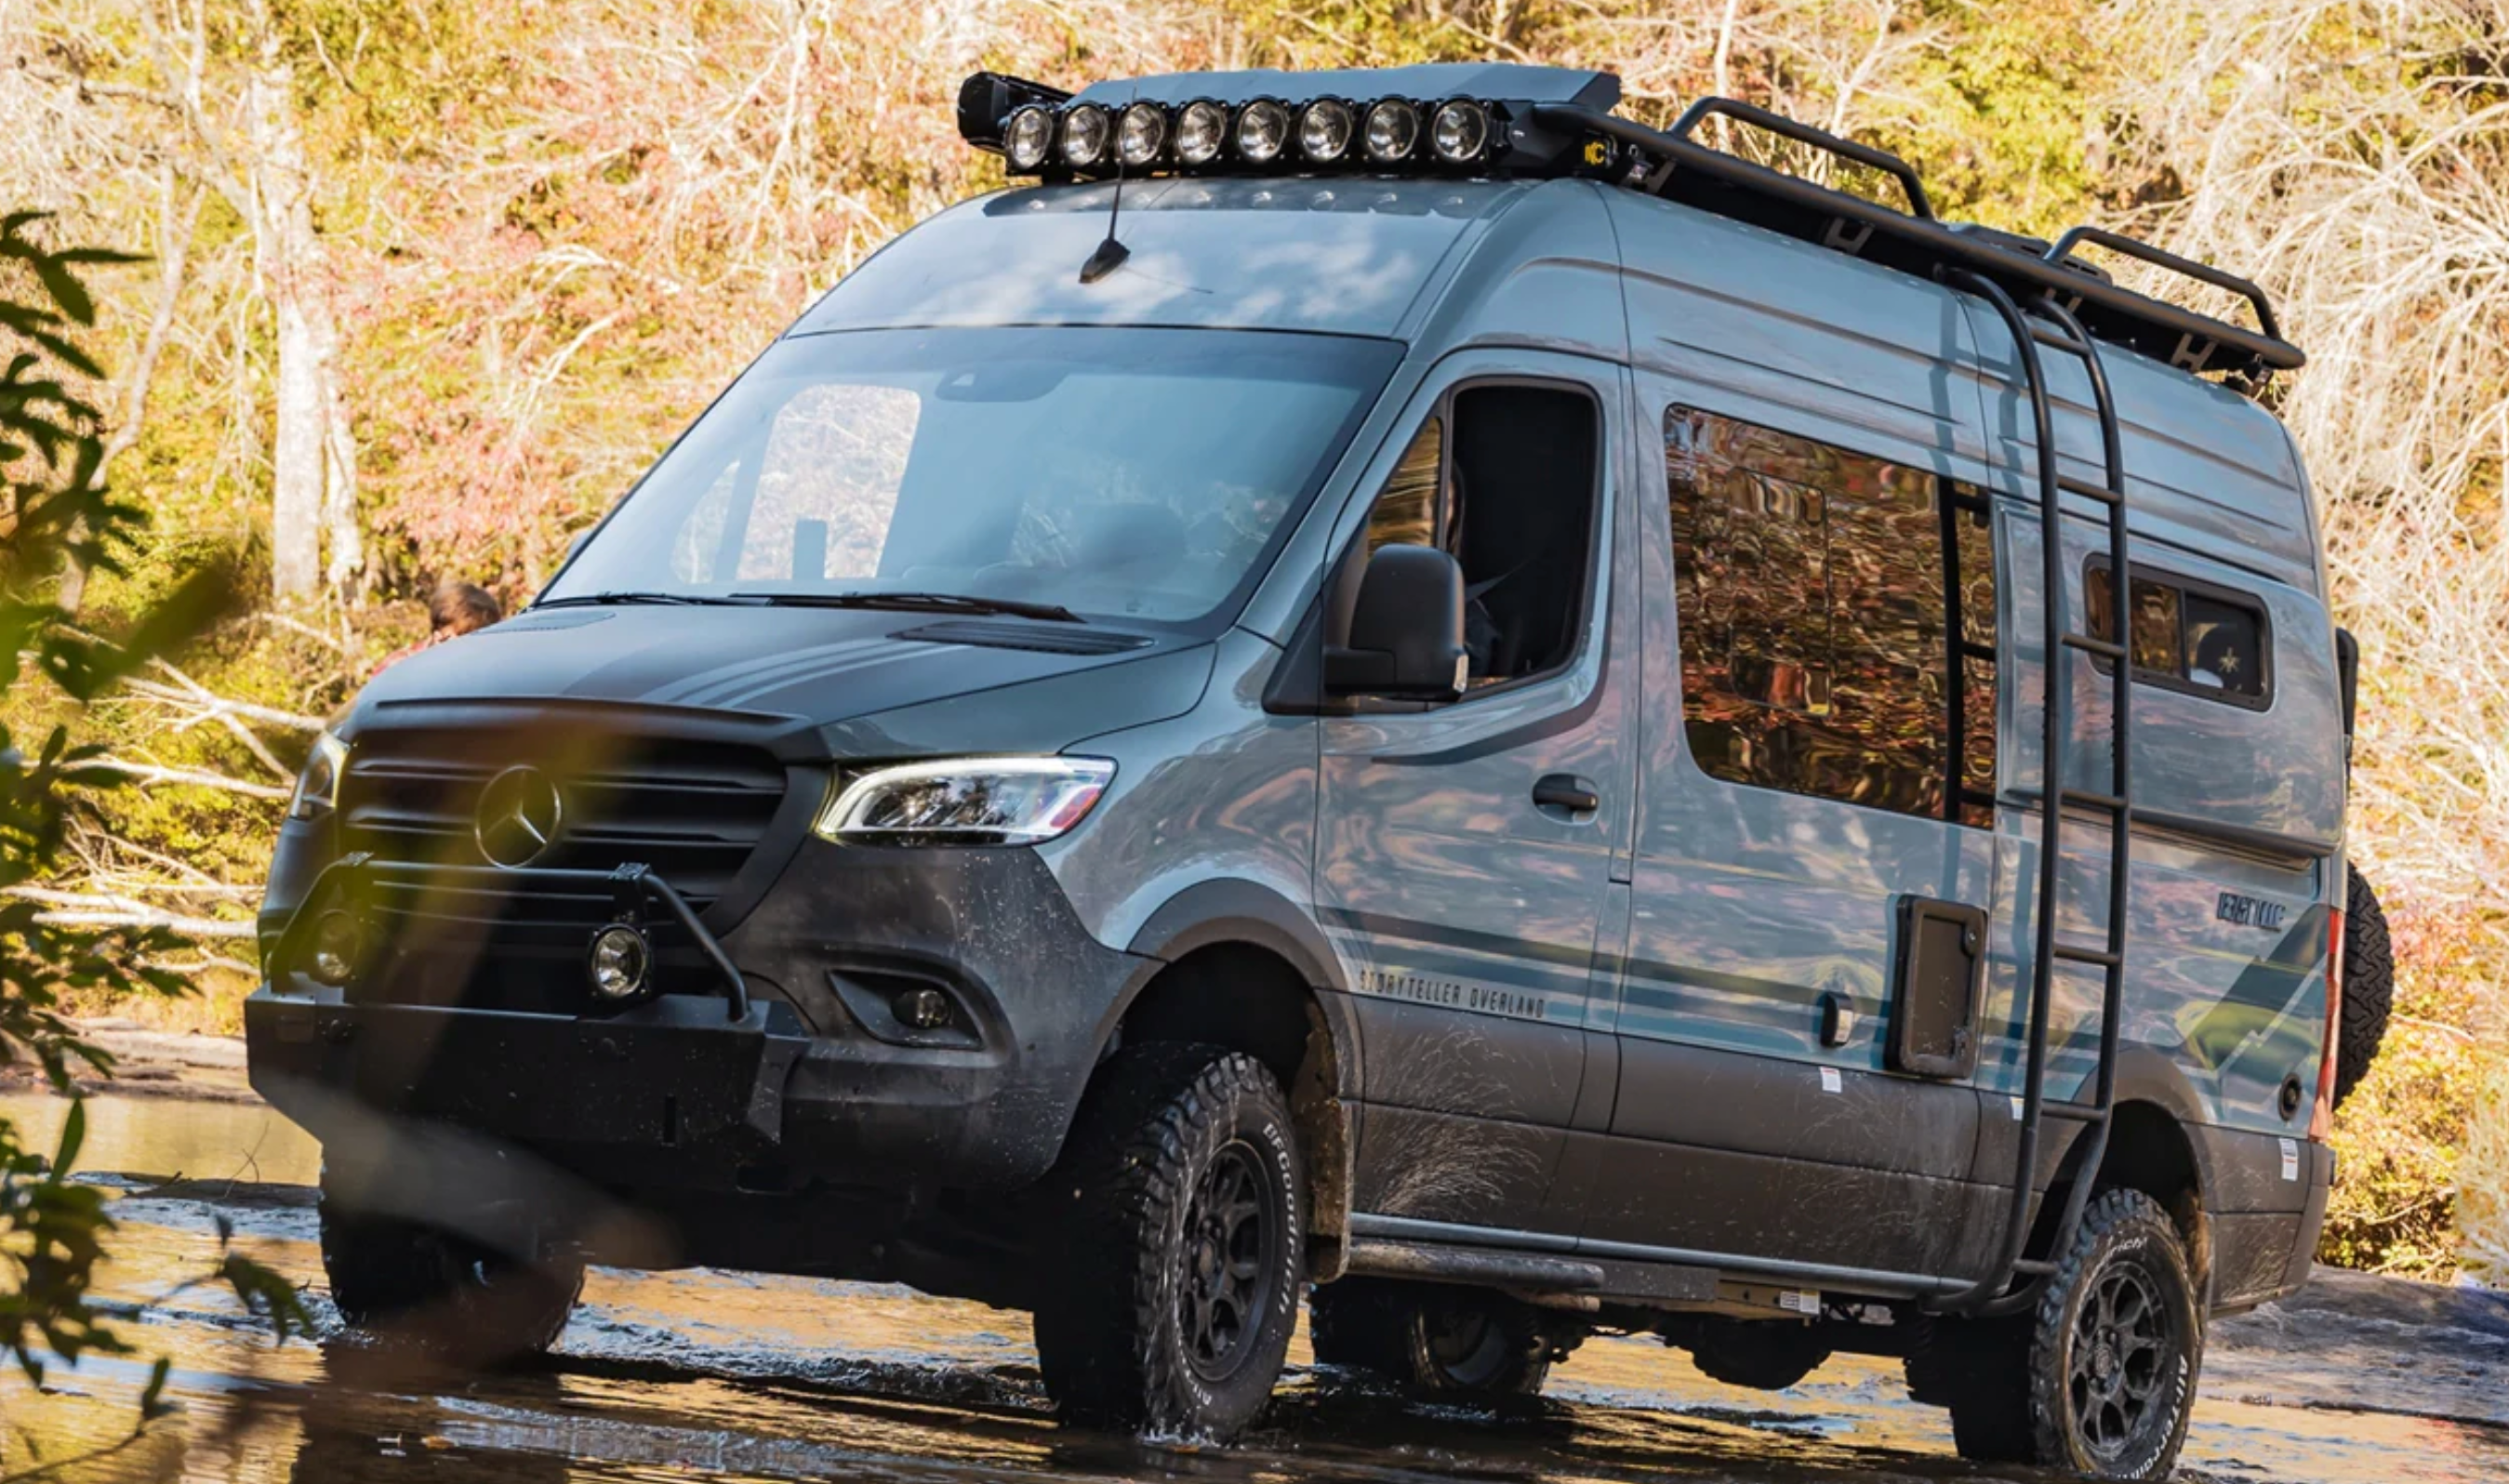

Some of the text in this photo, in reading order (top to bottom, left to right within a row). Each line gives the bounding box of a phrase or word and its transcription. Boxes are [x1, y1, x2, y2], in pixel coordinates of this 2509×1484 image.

[1360, 969, 1545, 1019] STORYTELLER OVERLAND
[1263, 1122, 1299, 1315] BFGoodrich
